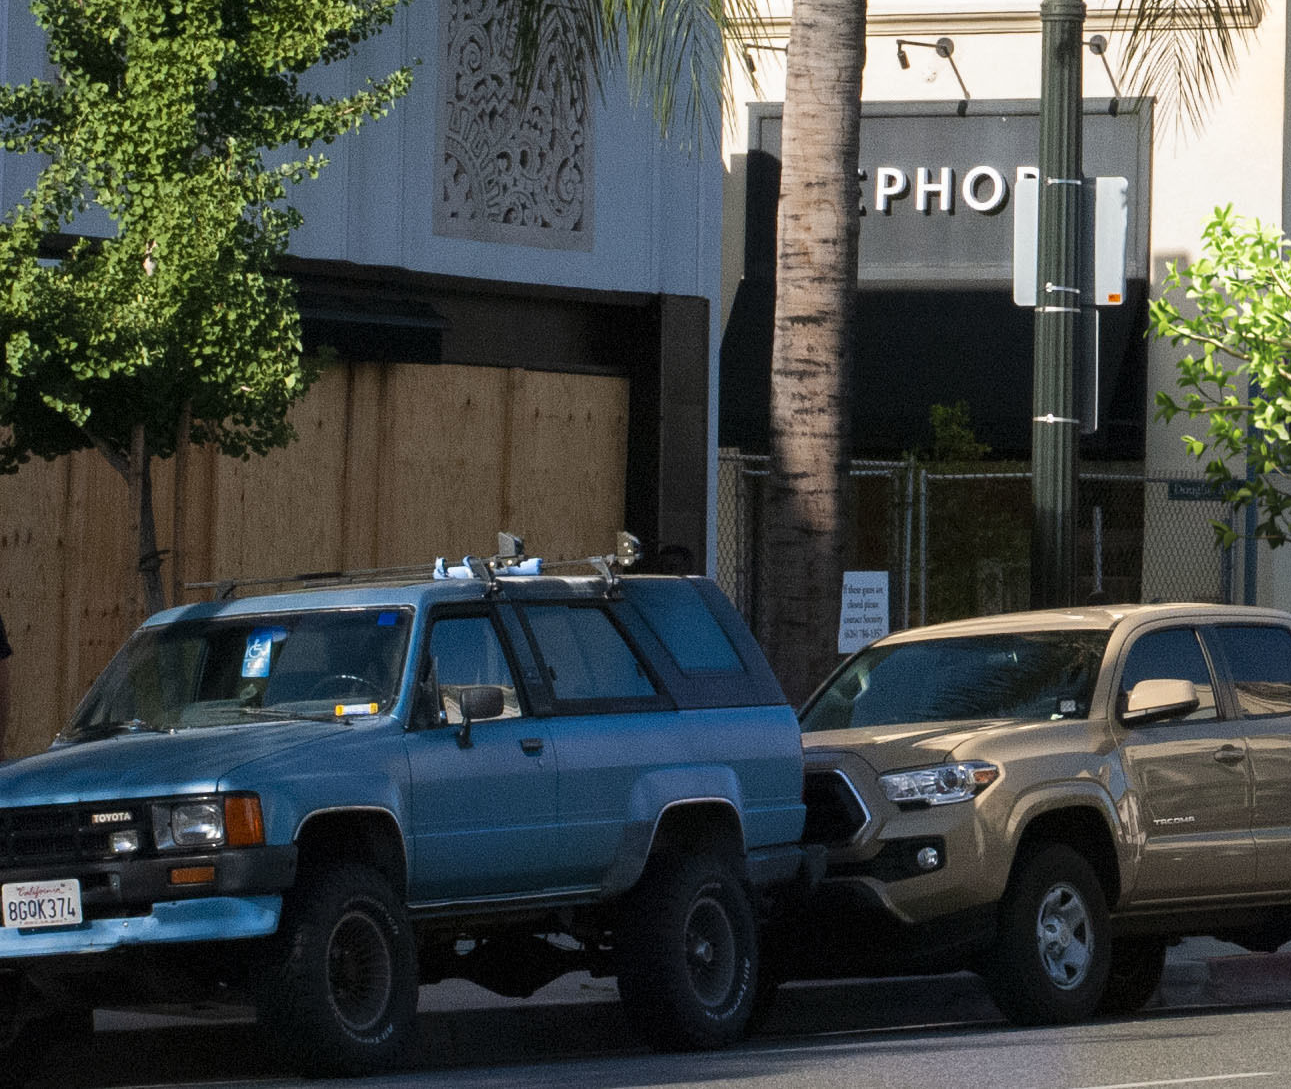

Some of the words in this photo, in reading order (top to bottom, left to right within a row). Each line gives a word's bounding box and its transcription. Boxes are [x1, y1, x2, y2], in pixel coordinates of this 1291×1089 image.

[92, 812, 131, 823] TOYOTA
[1153, 816, 1195, 825] TACOMA
[17, 886, 65, 898] California
